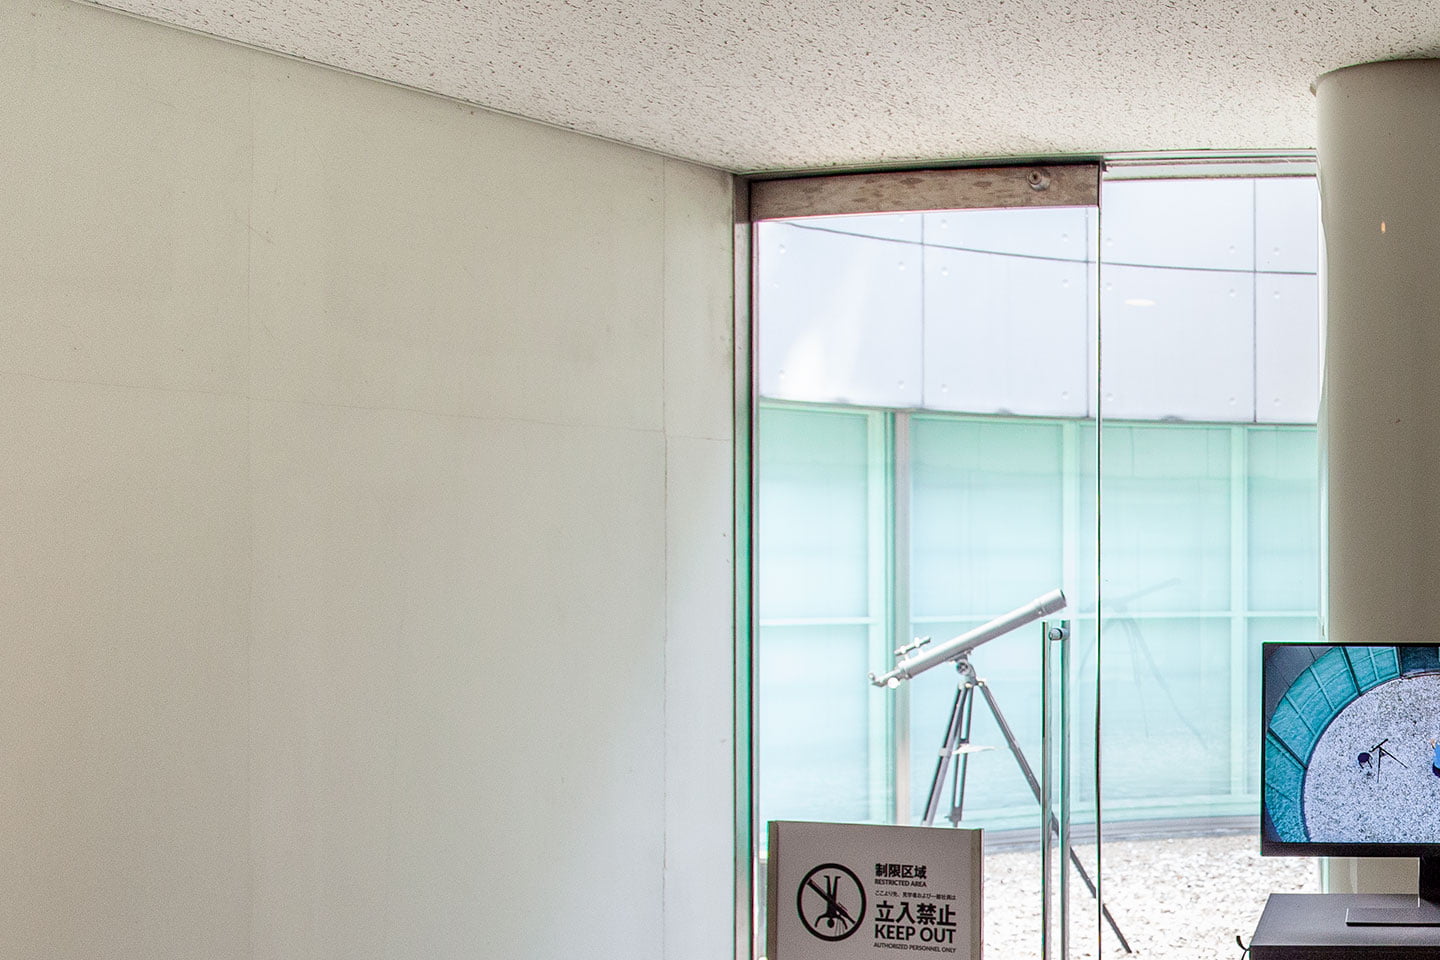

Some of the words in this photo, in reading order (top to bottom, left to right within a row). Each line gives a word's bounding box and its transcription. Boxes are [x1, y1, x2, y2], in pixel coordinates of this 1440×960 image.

[875, 863, 927, 879] 制限区域
[875, 879, 910, 887] RESTRICTED
[875, 900, 957, 926] 立入禁止
[875, 924, 916, 940] KEEP
[920, 927, 957, 943] OUT
[873, 942, 908, 950] AUTHORIZED
